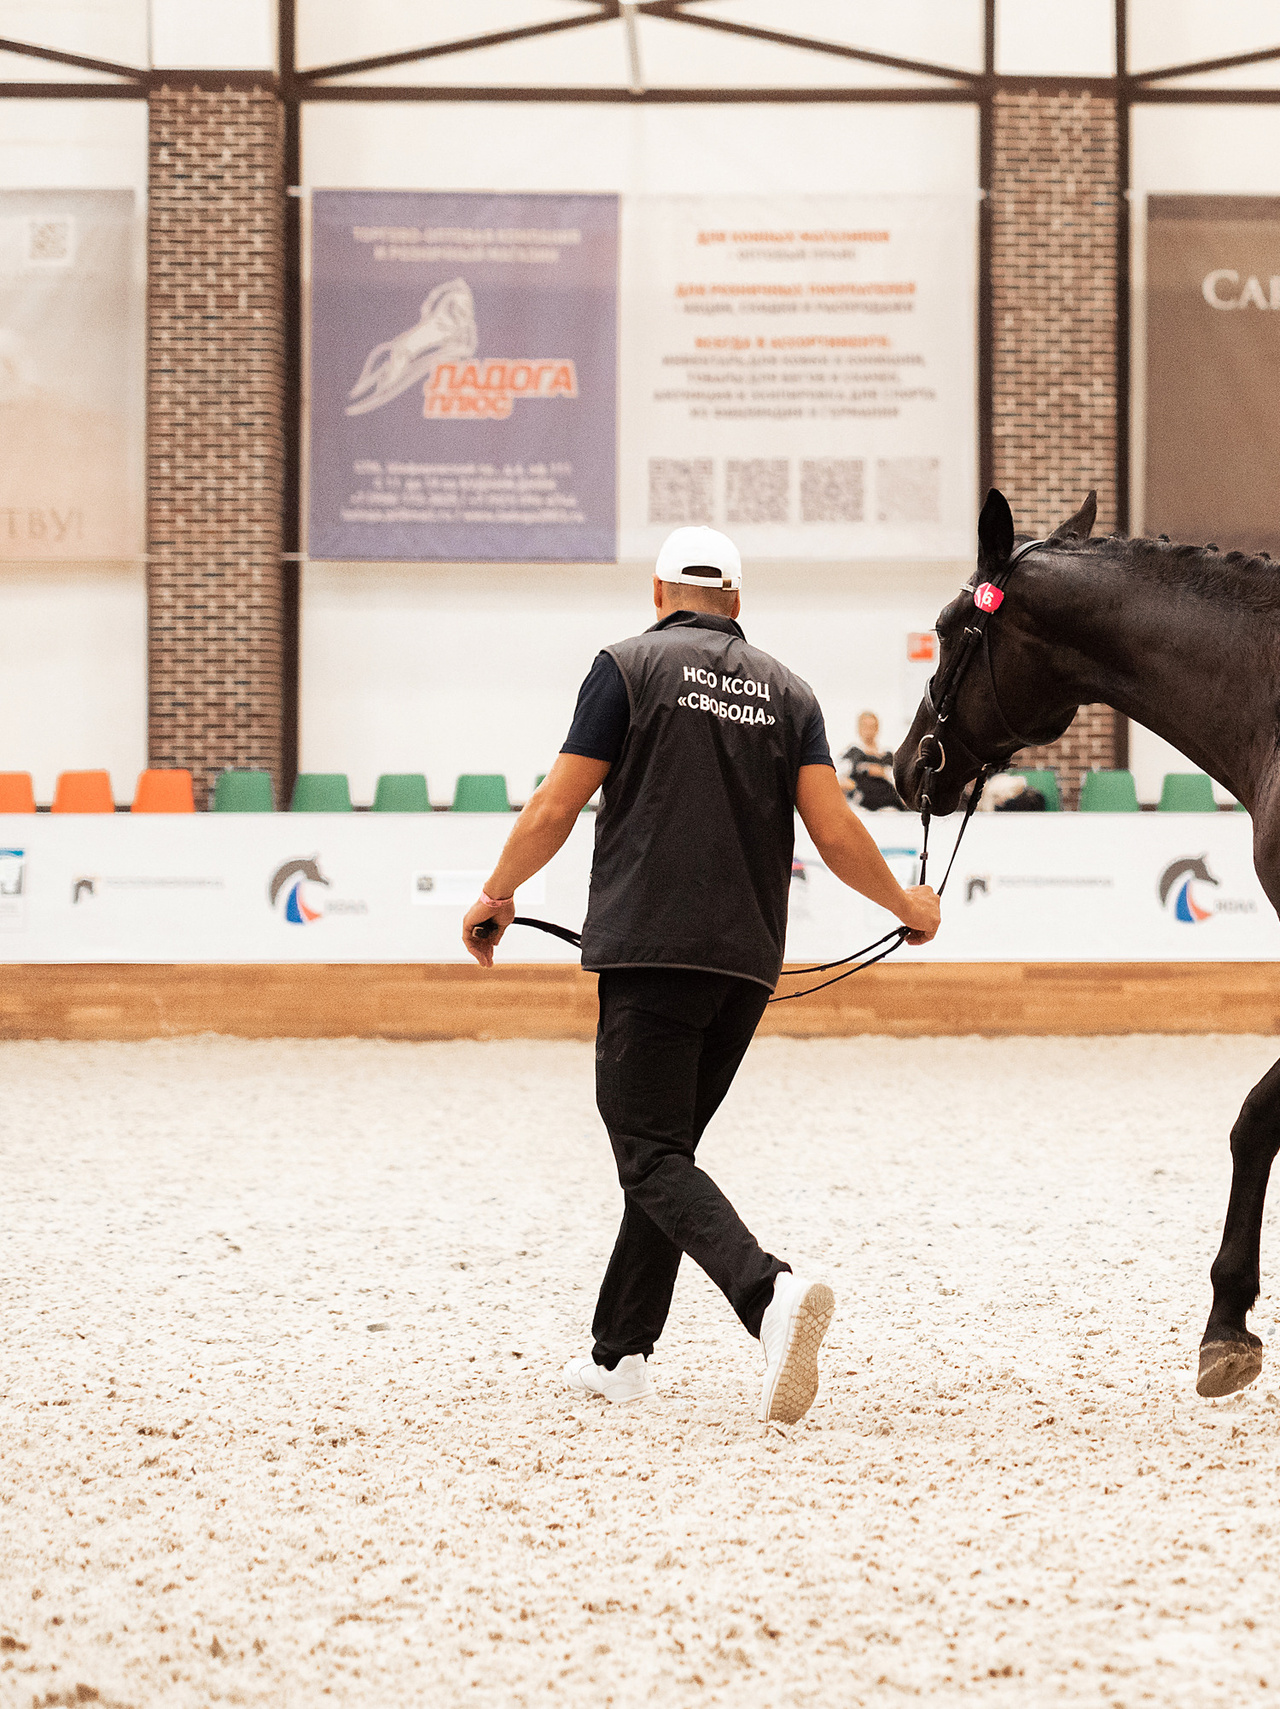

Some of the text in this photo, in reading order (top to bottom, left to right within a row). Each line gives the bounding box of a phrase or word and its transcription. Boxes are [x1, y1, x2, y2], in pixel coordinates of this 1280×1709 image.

[430, 363, 574, 391] ЛАДОГА
[683, 666, 770, 702] НСО КСОЦ
[678, 691, 776, 726] «СВОБОДА»
